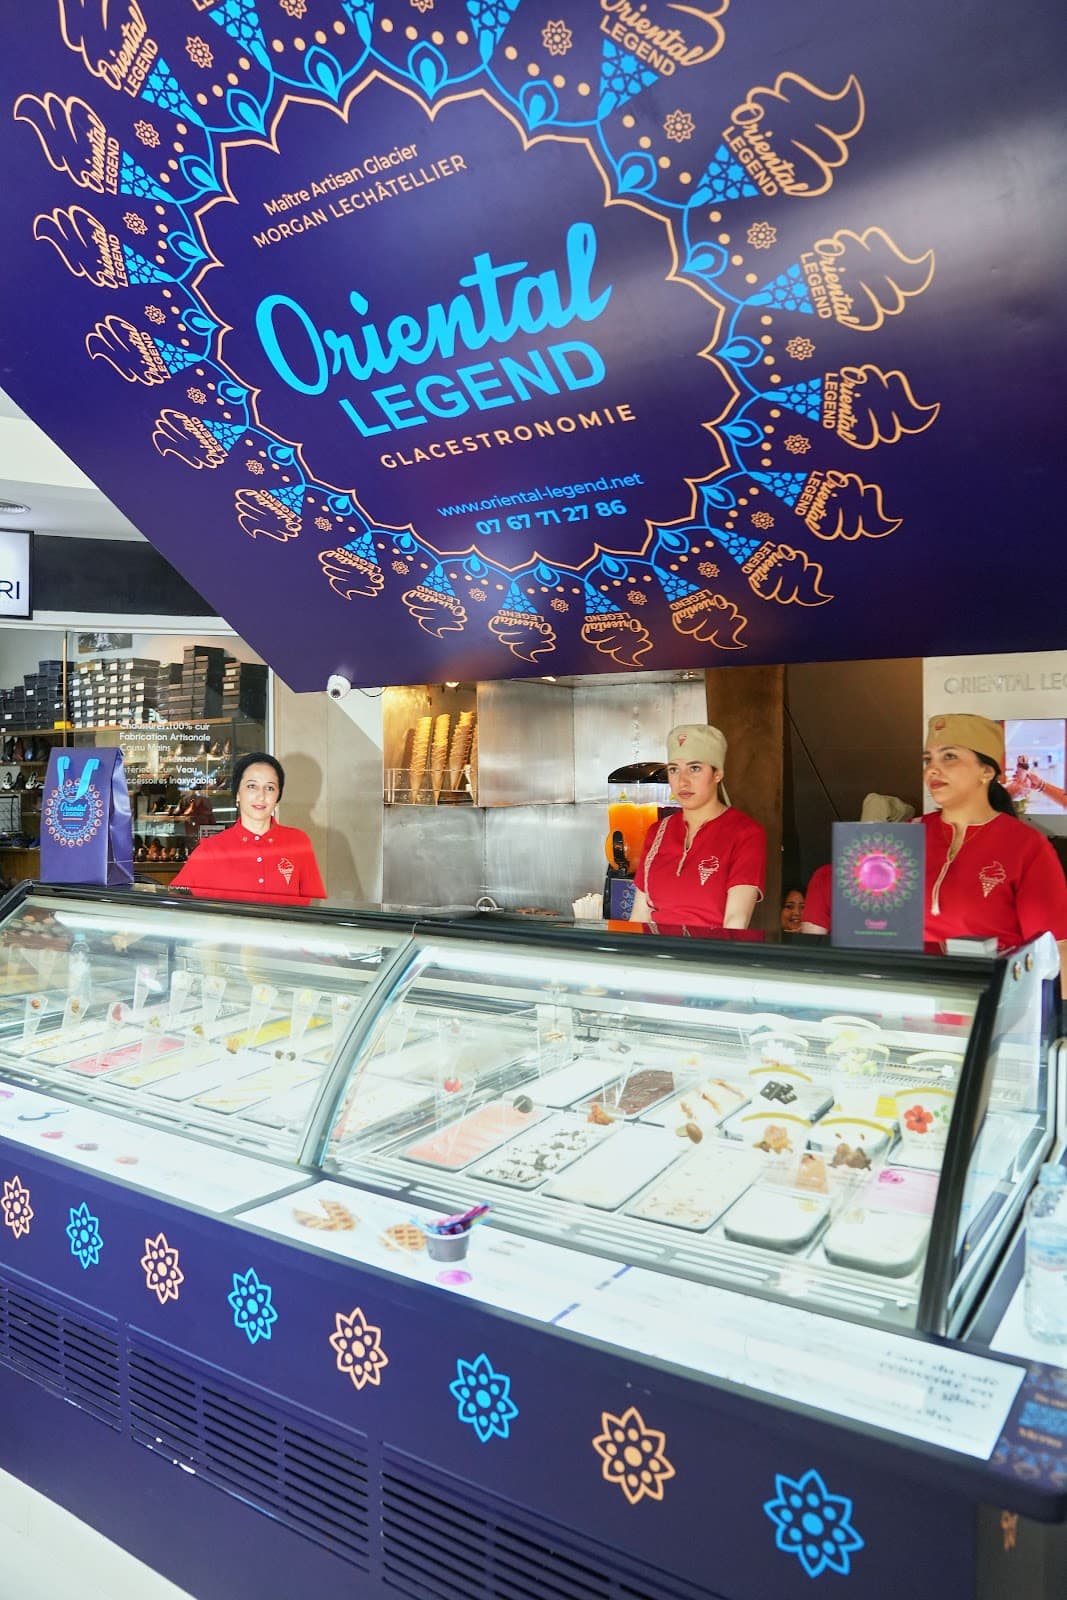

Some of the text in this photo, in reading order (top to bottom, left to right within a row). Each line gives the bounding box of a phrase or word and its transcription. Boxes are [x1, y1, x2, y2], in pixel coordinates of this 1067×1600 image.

[123, 38, 158, 98] LEGEND
[599, 14, 676, 77] LEGEND
[106, 137, 120, 196] LEGEND
[721, 125, 778, 197] LEGEND
[730, 102, 809, 195] Oriental
[252, 155, 467, 248] MORGAN LECHÂTELLIER
[263, 144, 418, 215] Maître Artisan Glacier
[108, 234, 129, 288] LEGEND
[800, 251, 833, 319] LEGEND
[813, 238, 860, 326] Oriental
[255, 222, 612, 395] Oriental
[140, 331, 172, 379] LEGEND
[339, 341, 606, 437] LEGEND
[823, 372, 839, 430] LEGEND
[837, 366, 867, 442] Oriental
[191, 416, 229, 458] LEGEND
[380, 404, 636, 468] GLACESTRONOMIE
[259, 489, 303, 523] LEGEND
[437, 473, 644, 517] www.oriental-legend.net
[794, 470, 824, 516] LEGEND
[476, 500, 627, 535] 07 67 71 27 86
[336, 547, 382, 573] LEGEND
[741, 541, 776, 574] LEGEND
[416, 585, 461, 605] LEGEND
[498, 609, 545, 623] LEGEND
[584, 612, 631, 622] LEGEND
[669, 588, 713, 611] LEGEND
[944, 673, 1035, 694] ORIENTAL
[119, 732, 211, 742] Fabrication Artisanale
[125, 776, 168, 785] ccessoires
[175, 764, 198, 774] Veau
